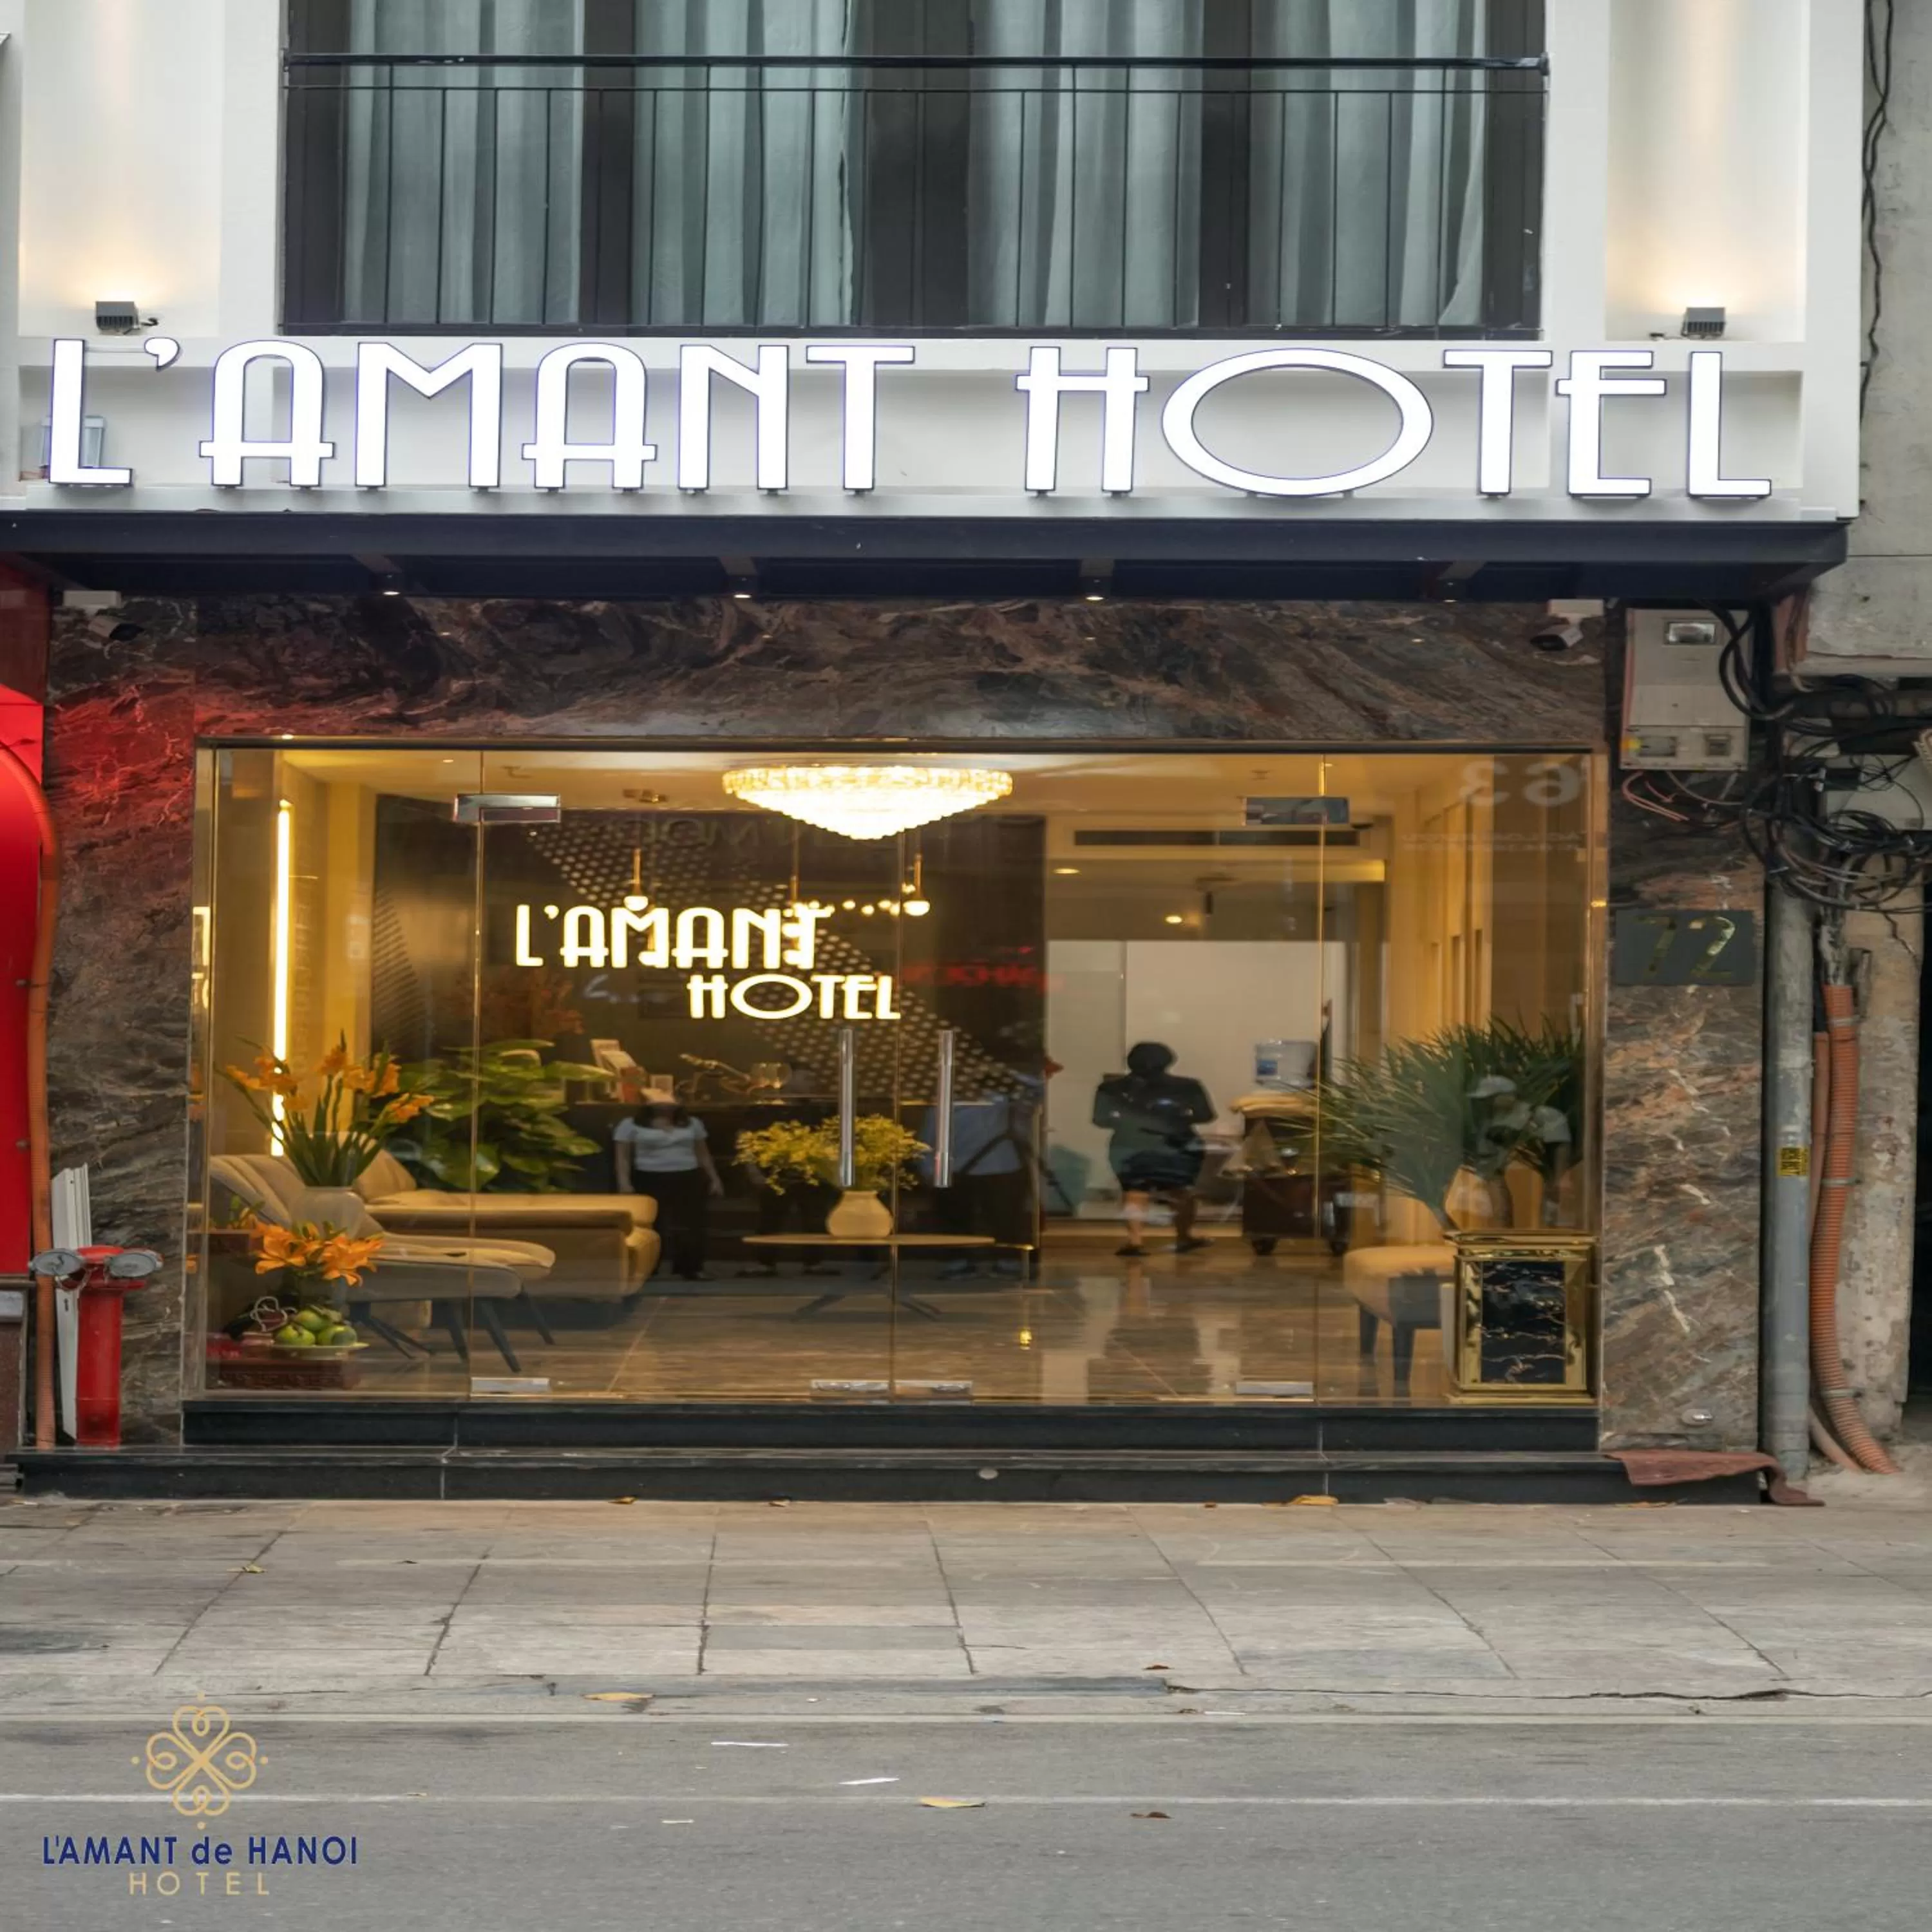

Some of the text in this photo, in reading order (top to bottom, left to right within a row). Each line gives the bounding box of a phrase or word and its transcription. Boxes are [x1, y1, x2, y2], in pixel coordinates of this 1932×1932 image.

[48, 337, 1772, 497] L'AMANT HOTEL
[516, 904, 832, 969] L'AMANT
[1634, 914, 1737, 978] 72
[687, 973, 901, 1019] HOTEL
